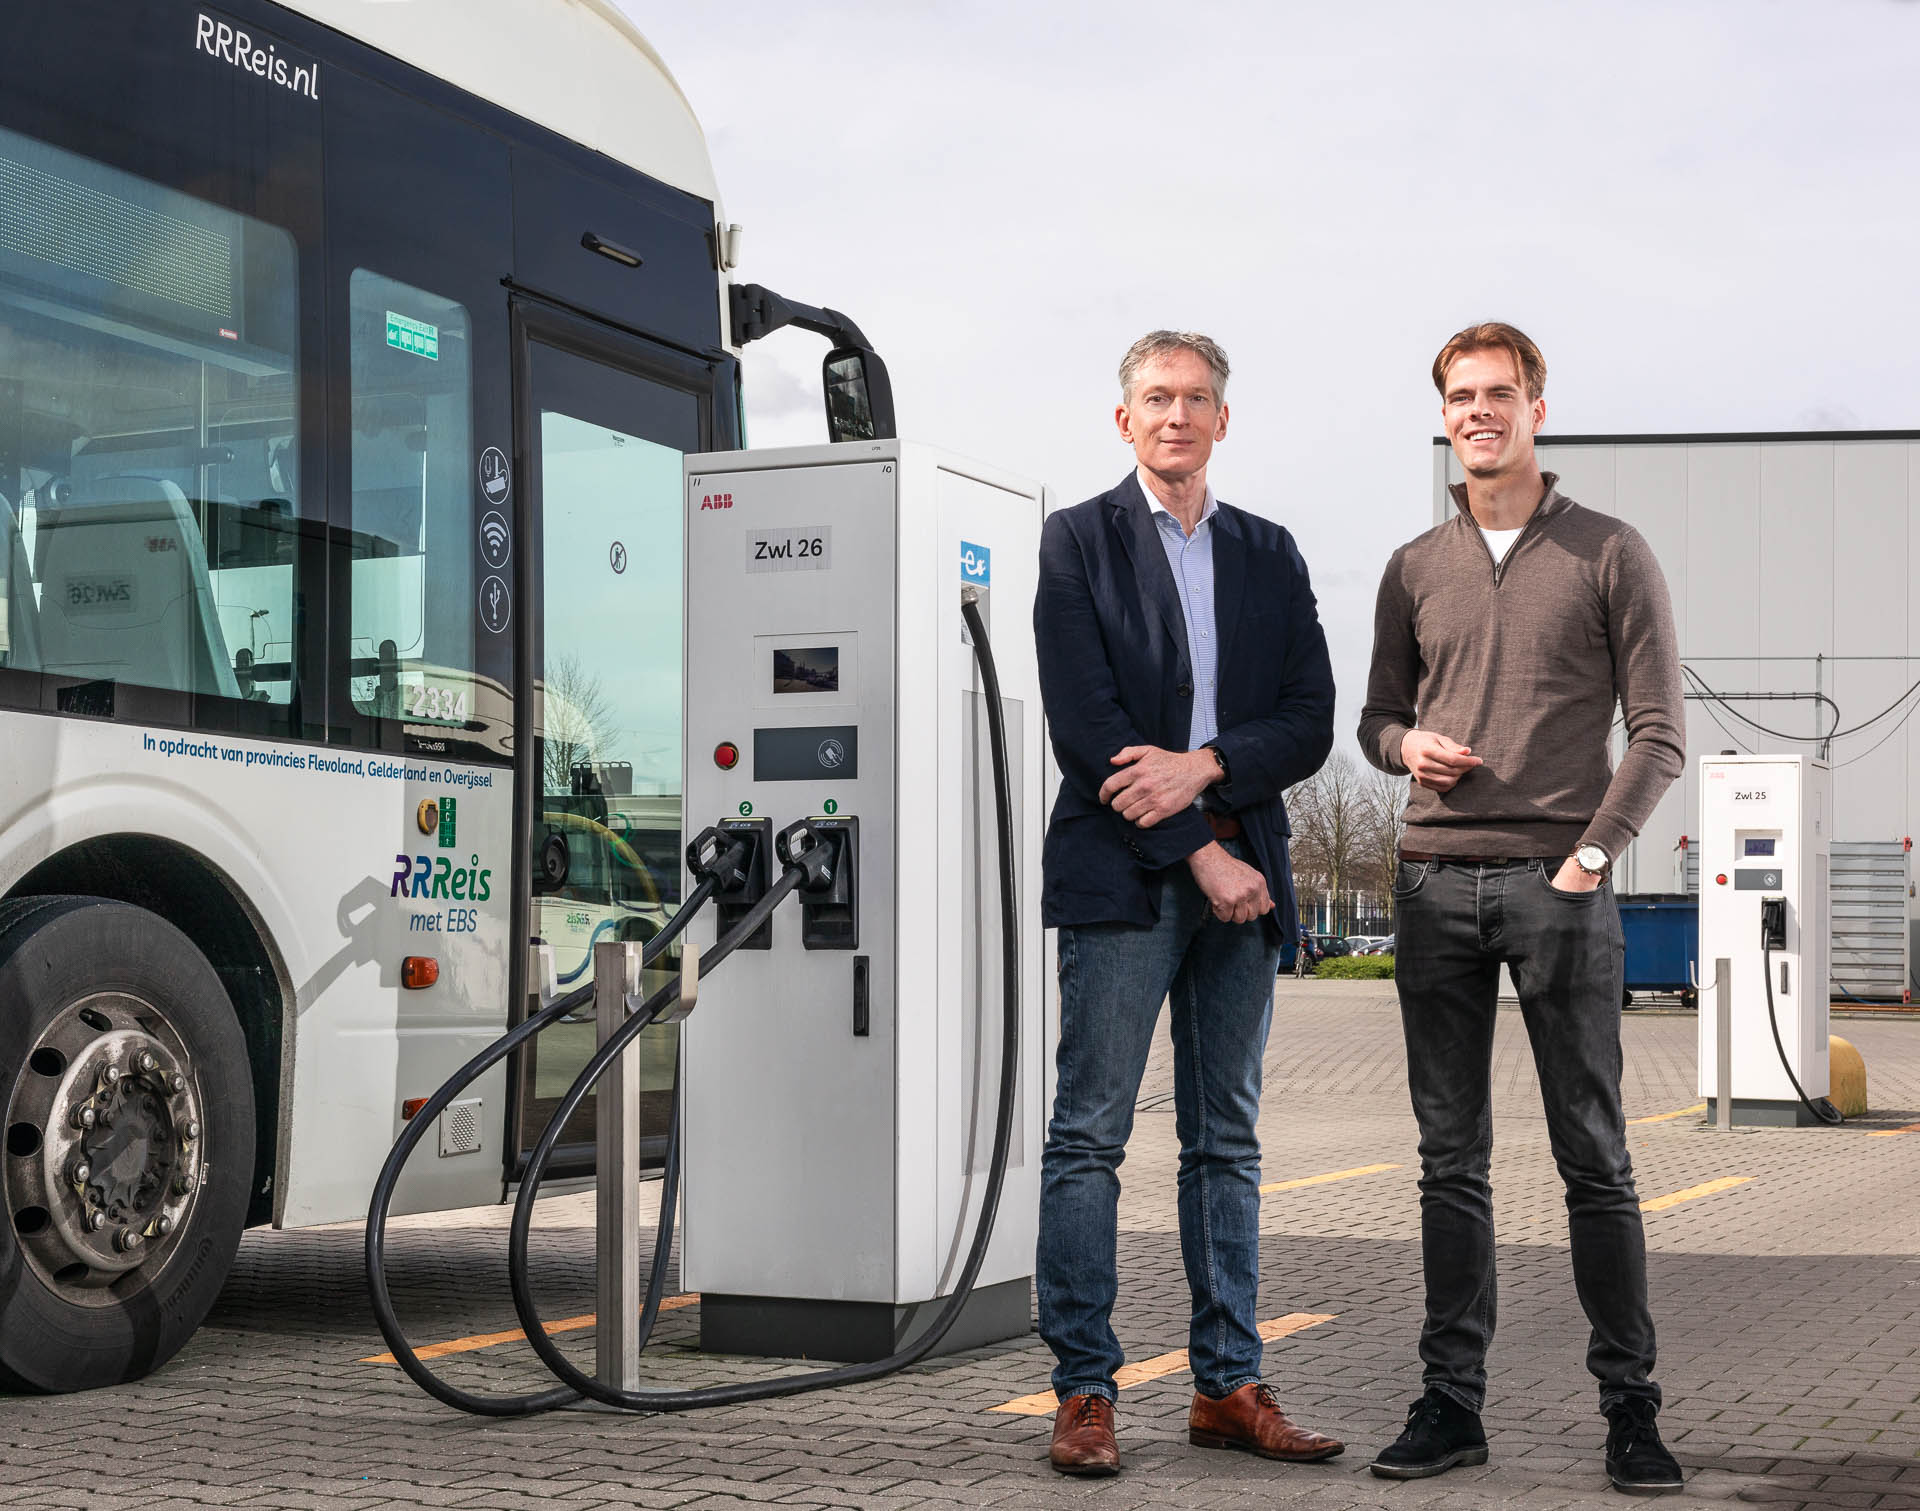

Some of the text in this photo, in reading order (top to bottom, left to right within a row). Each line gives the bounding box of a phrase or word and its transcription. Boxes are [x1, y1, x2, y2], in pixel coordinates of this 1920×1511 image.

[195, 12, 319, 101] RRReis.nl
[700, 493, 734, 511] ABB
[754, 537, 823, 560] Zwl 26
[412, 685, 467, 723] 2334
[143, 733, 493, 790] In opdracht van provincies Flevoland, Gelderland en Overijssel
[1735, 791, 1767, 800] Zwl 25
[742, 803, 751, 815] 2
[390, 853, 492, 902] RRReis
[409, 908, 478, 933] met EBS
